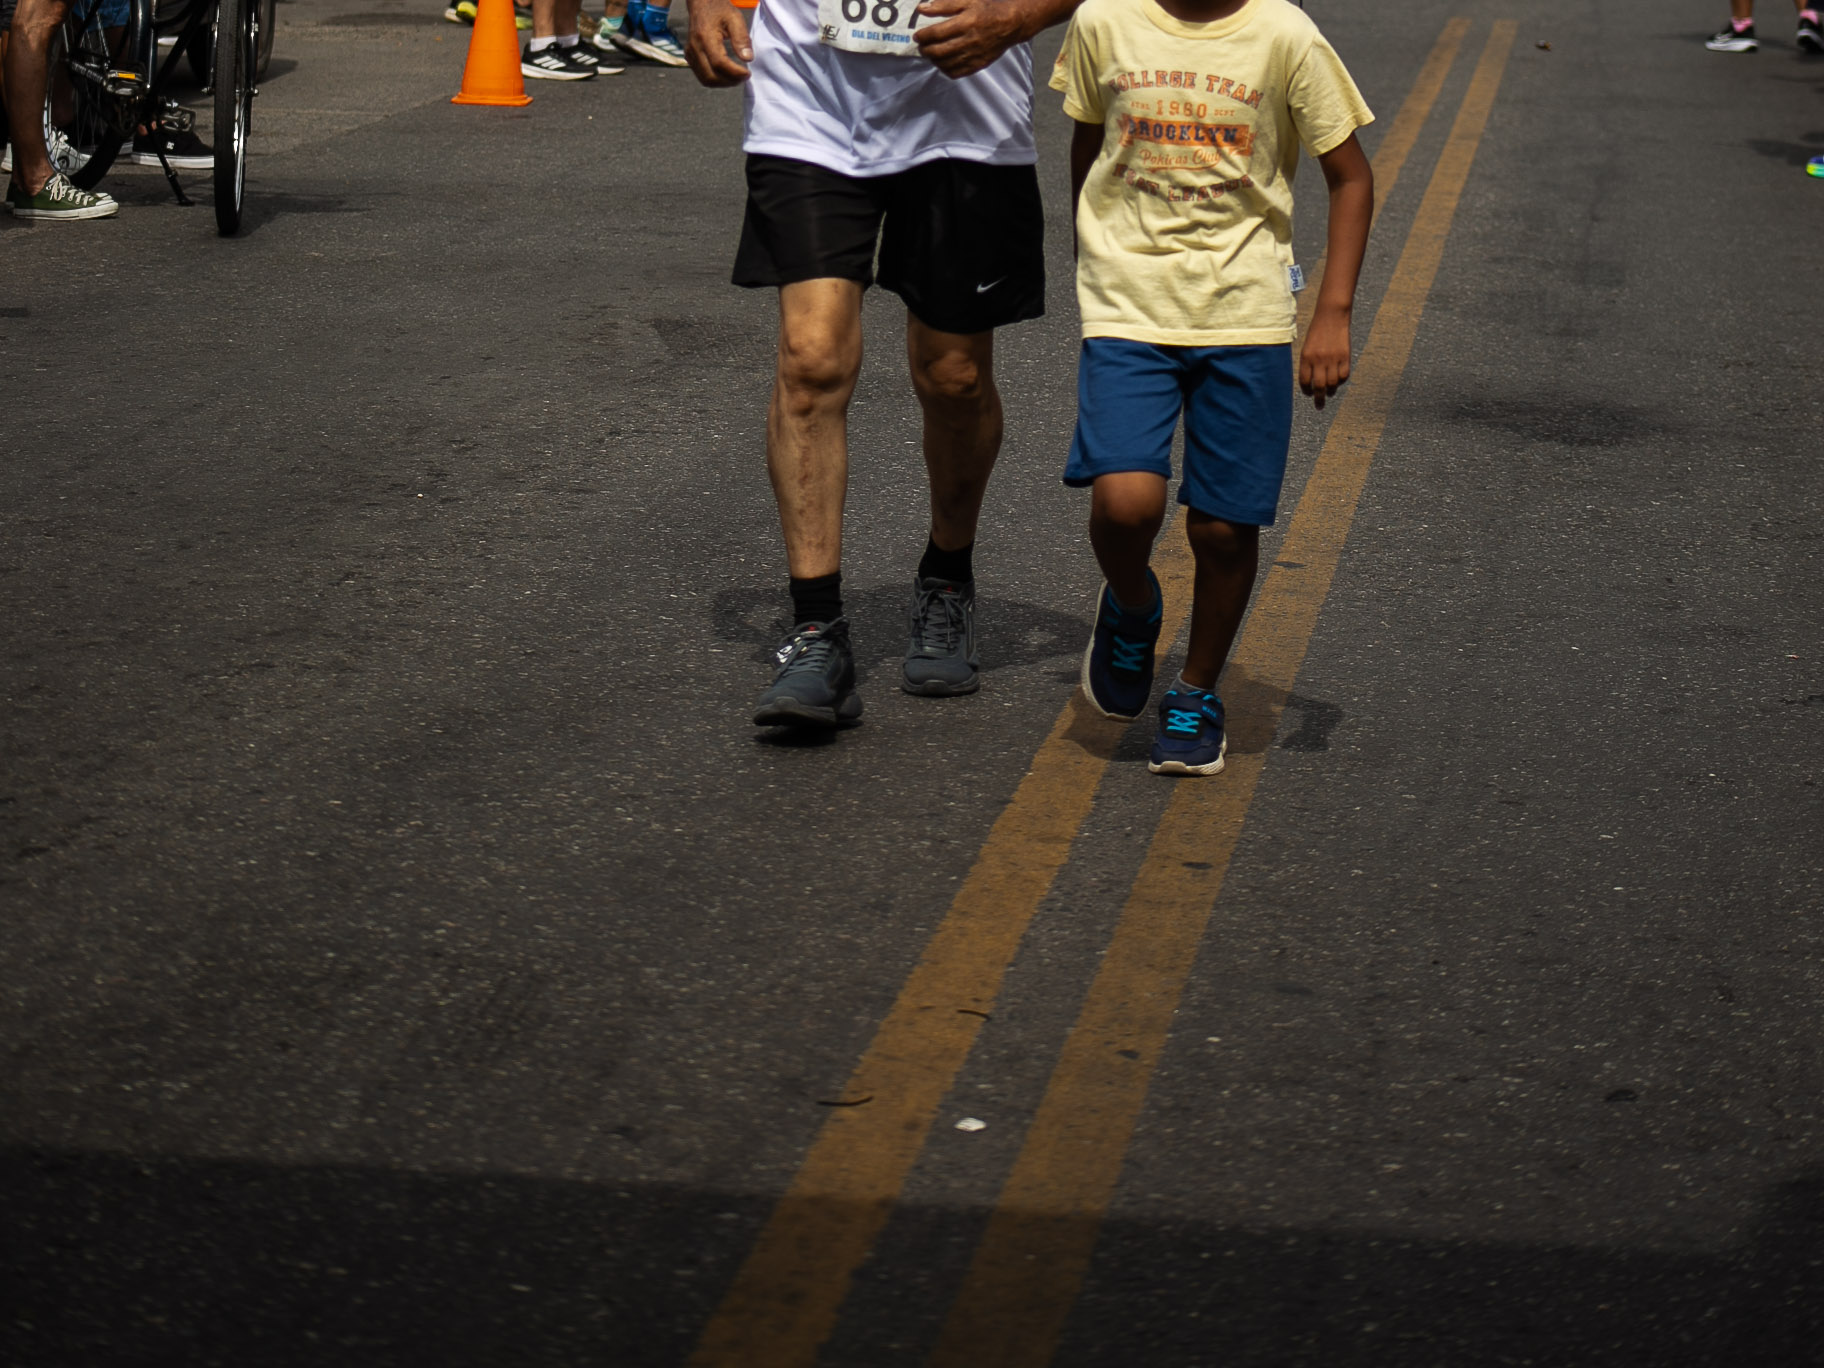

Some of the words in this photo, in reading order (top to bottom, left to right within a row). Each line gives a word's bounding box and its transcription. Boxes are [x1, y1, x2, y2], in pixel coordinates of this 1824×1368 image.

[866, 30, 880, 41] DEL
[882, 31, 911, 44] VECINO
[1108, 70, 1197, 95] COLLEGE
[1206, 74, 1265, 110] TEAM
[1128, 118, 1239, 143] BROOKLYN
